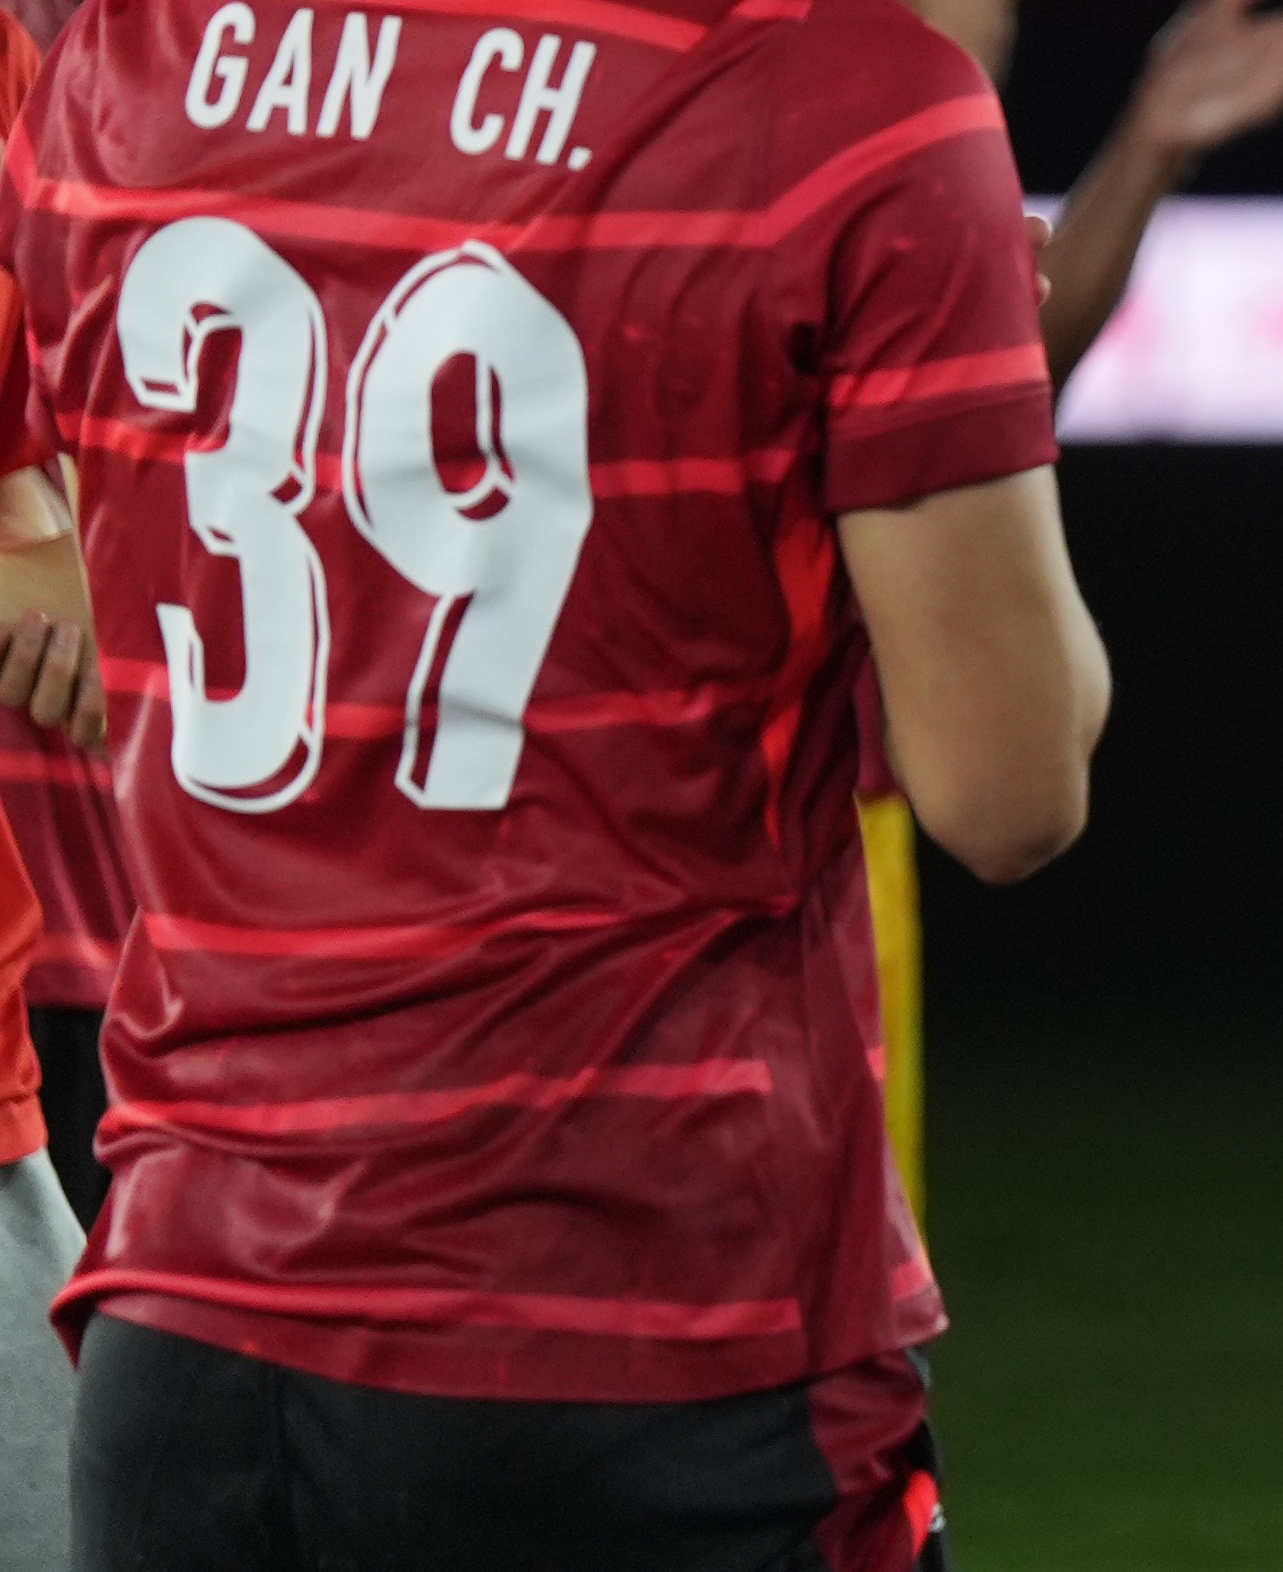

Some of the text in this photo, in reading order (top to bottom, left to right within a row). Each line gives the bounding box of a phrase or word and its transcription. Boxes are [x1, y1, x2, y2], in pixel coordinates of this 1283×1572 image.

[184, 1, 597, 171] GAN CH.
[116, 215, 594, 814] 39
